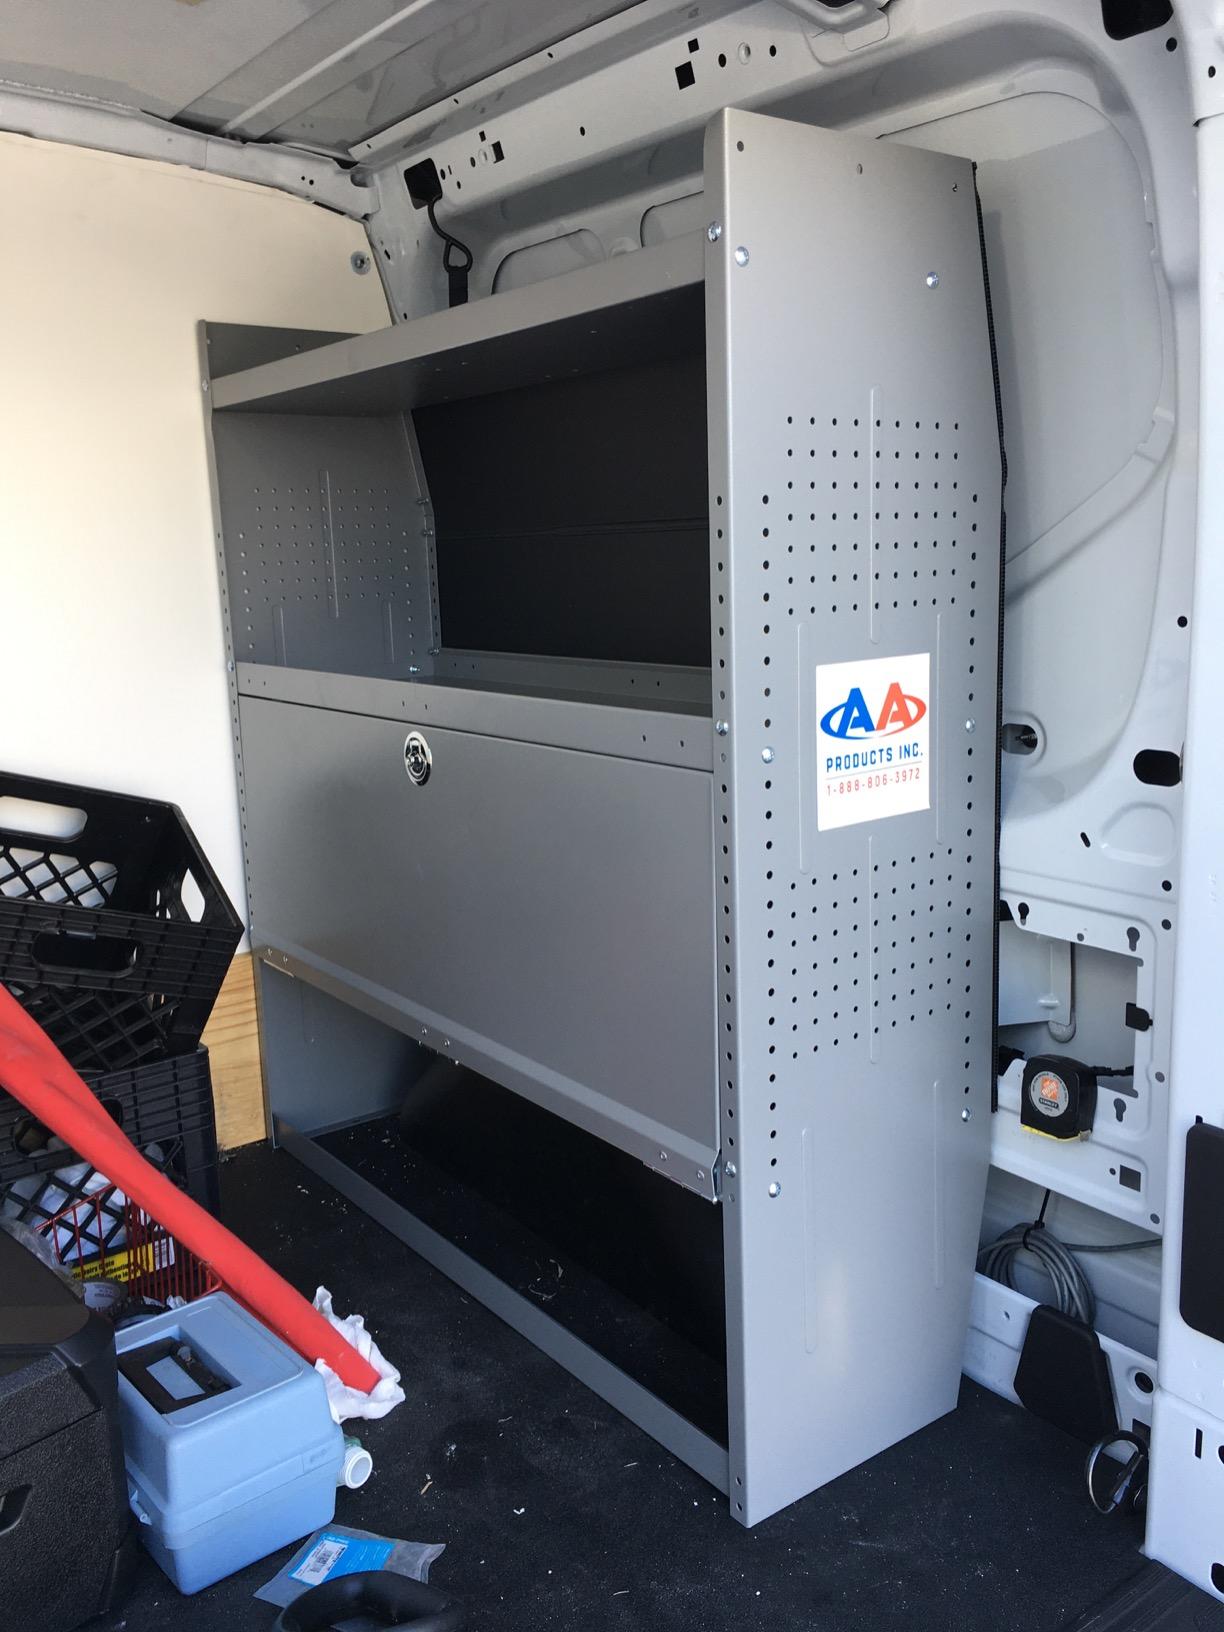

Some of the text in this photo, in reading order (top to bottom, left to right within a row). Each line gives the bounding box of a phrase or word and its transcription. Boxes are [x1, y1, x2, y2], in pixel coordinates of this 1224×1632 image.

[836, 682, 913, 737] AA
[826, 742, 924, 773] PRODUCTS INC.
[826, 767, 921, 797] 1-888-806-3972
